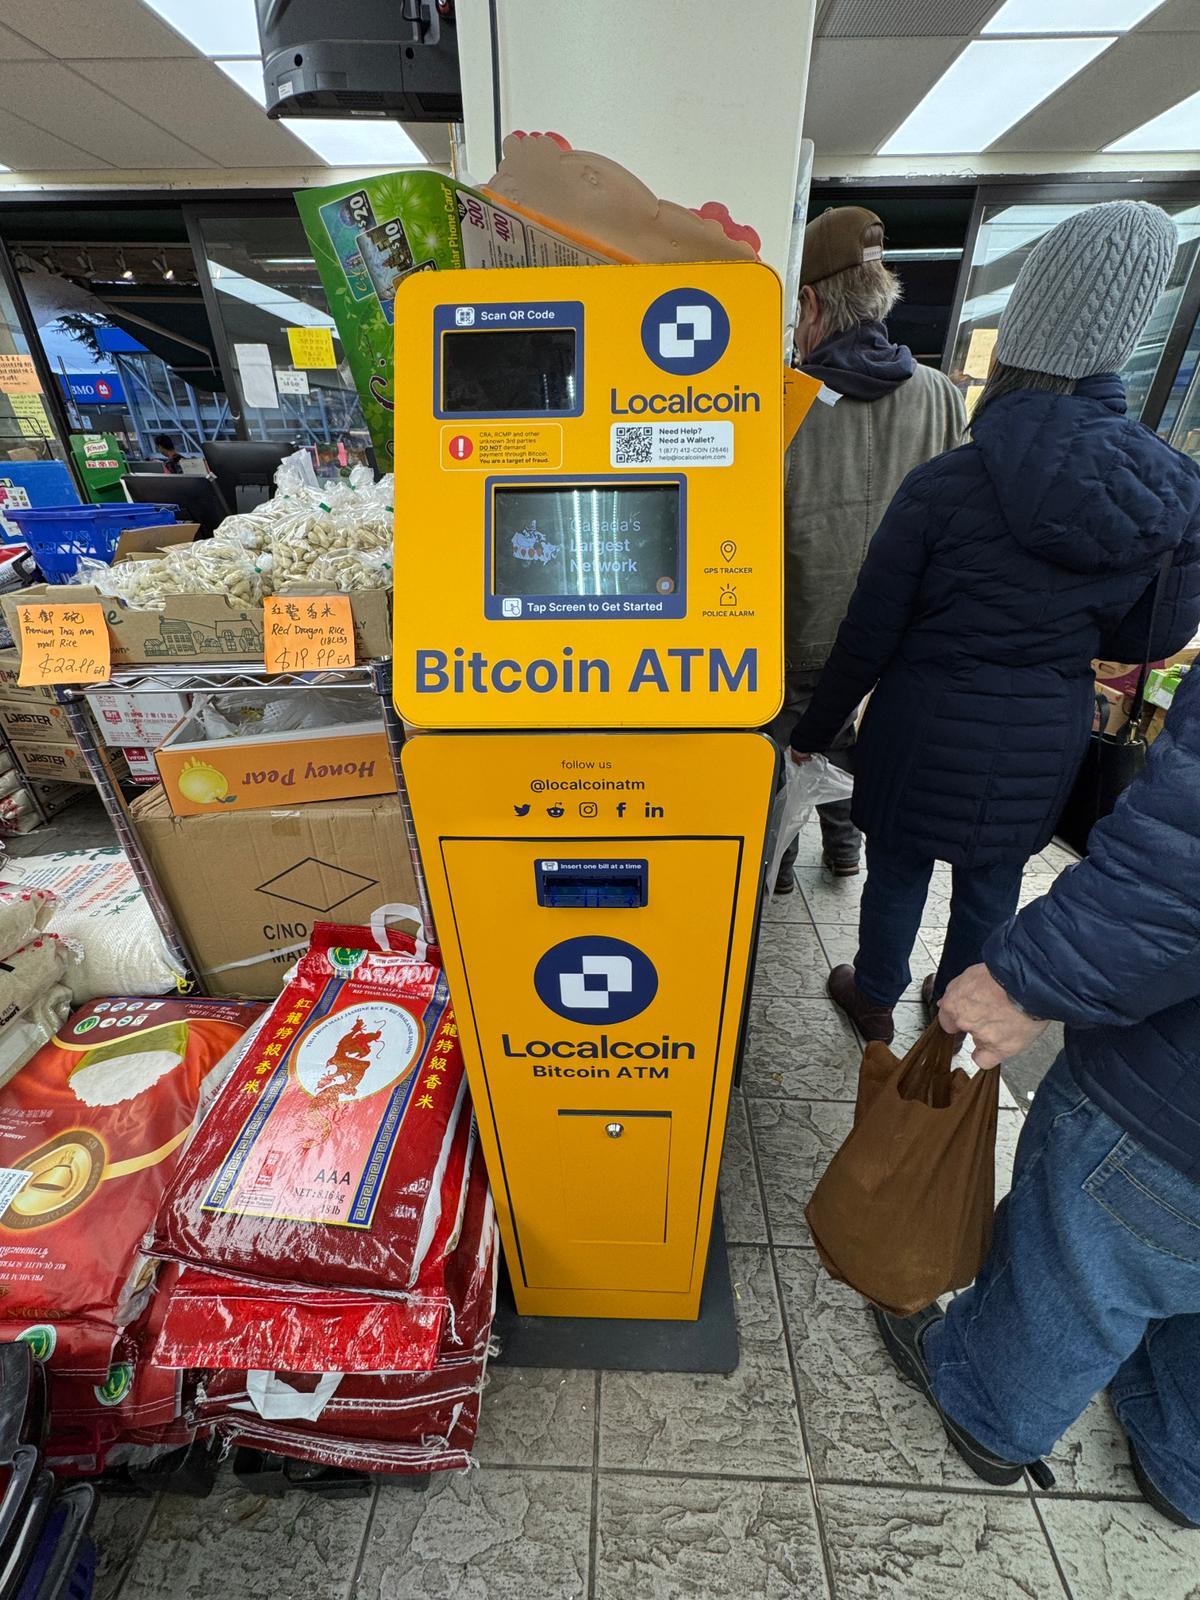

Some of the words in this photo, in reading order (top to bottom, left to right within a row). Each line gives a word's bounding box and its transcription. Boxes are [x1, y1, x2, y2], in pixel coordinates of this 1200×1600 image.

[467, 198, 485, 230] 500
[448, 214, 458, 246] Phone
[494, 212, 510, 242] 400
[481, 312, 506, 320] Scan
[509, 310, 524, 320] QR
[527, 310, 555, 320] Code
[611, 385, 760, 414] Localcoin
[680, 428, 702, 436] Help?
[570, 519, 641, 532] Caada's
[527, 602, 546, 614] Tap
[550, 603, 586, 612] Screen
[589, 603, 598, 612] to
[602, 602, 620, 612] Get
[623, 602, 662, 612] Started
[272, 623, 292, 636] Red
[294, 625, 324, 640] Dragon
[328, 626, 345, 636] Rice
[60, 639, 78, 648] Rice
[274, 648, 335, 671] $19.99
[415, 646, 610, 694] Bitcoin
[628, 648, 758, 693] ATM
[4, 713, 52, 726] LOBSTER
[24, 753, 66, 768] LOBSTER
[561, 760, 594, 769] follow
[242, 768, 296, 786] Pear
[304, 760, 375, 779] Honey
[530, 779, 645, 793] @localcoinatm
[502, 1034, 696, 1059] Localcoin
[532, 1065, 610, 1078] Bitcoin
[616, 1066, 669, 1079] ATM
[314, 1169, 350, 1185] AAA
